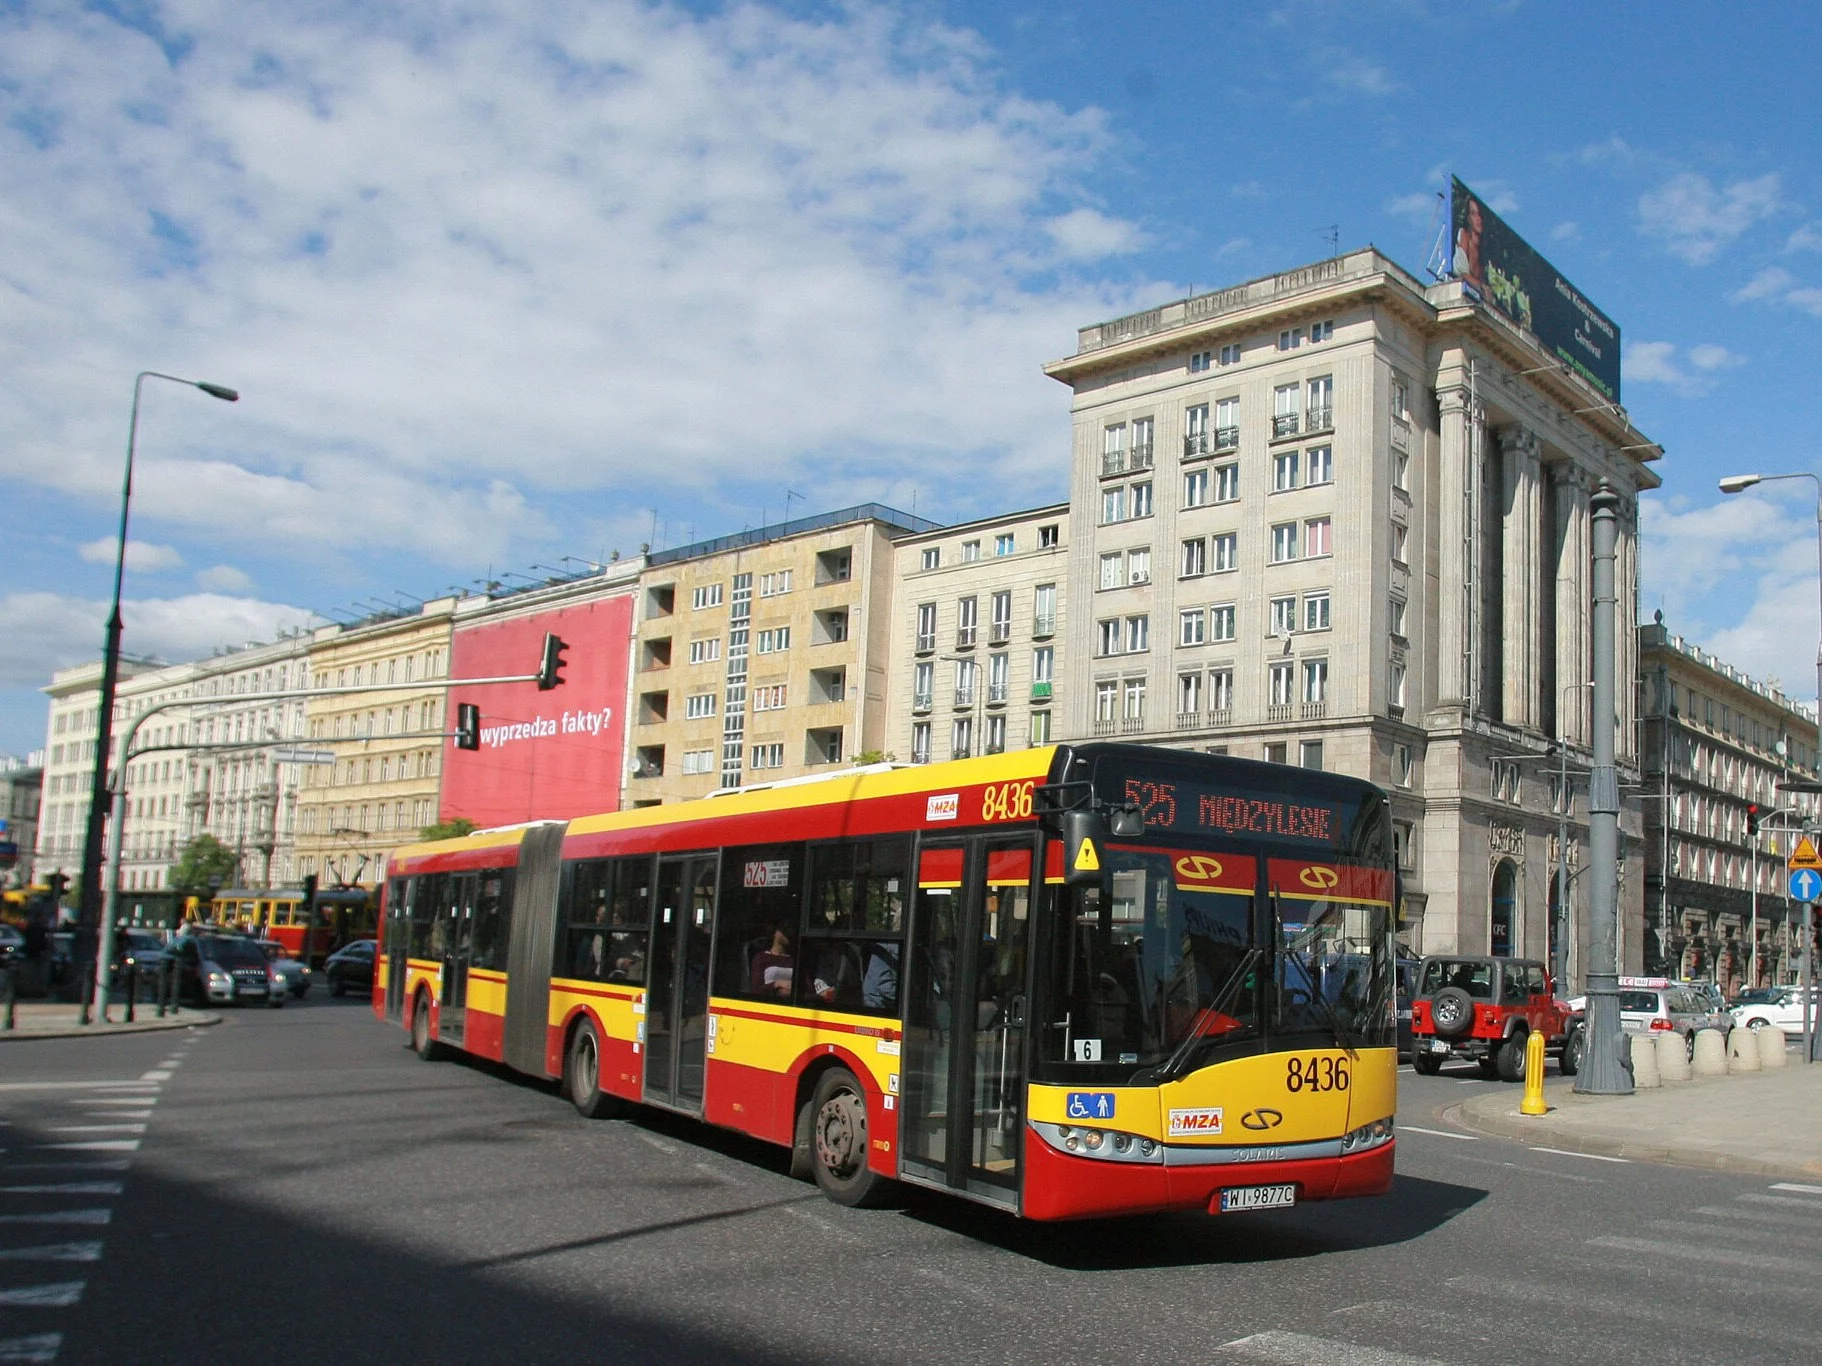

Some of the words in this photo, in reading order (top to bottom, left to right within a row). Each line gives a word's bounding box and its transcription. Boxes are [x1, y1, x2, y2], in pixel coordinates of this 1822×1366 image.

[479, 716, 556, 748] wyprzedza
[561, 707, 612, 736] fakty?
[934, 800, 956, 815] MZA
[981, 780, 1035, 821] 8436
[1125, 779, 1176, 827] 525
[1199, 794, 1331, 840] MIĘDZYLESIE
[745, 860, 767, 886] 525
[1083, 1040, 1092, 1061] 6
[1286, 1056, 1349, 1093] 8436
[1182, 1113, 1220, 1129] MZA
[1230, 1190, 1246, 1207] WI
[1253, 1186, 1293, 1205] 9877C
